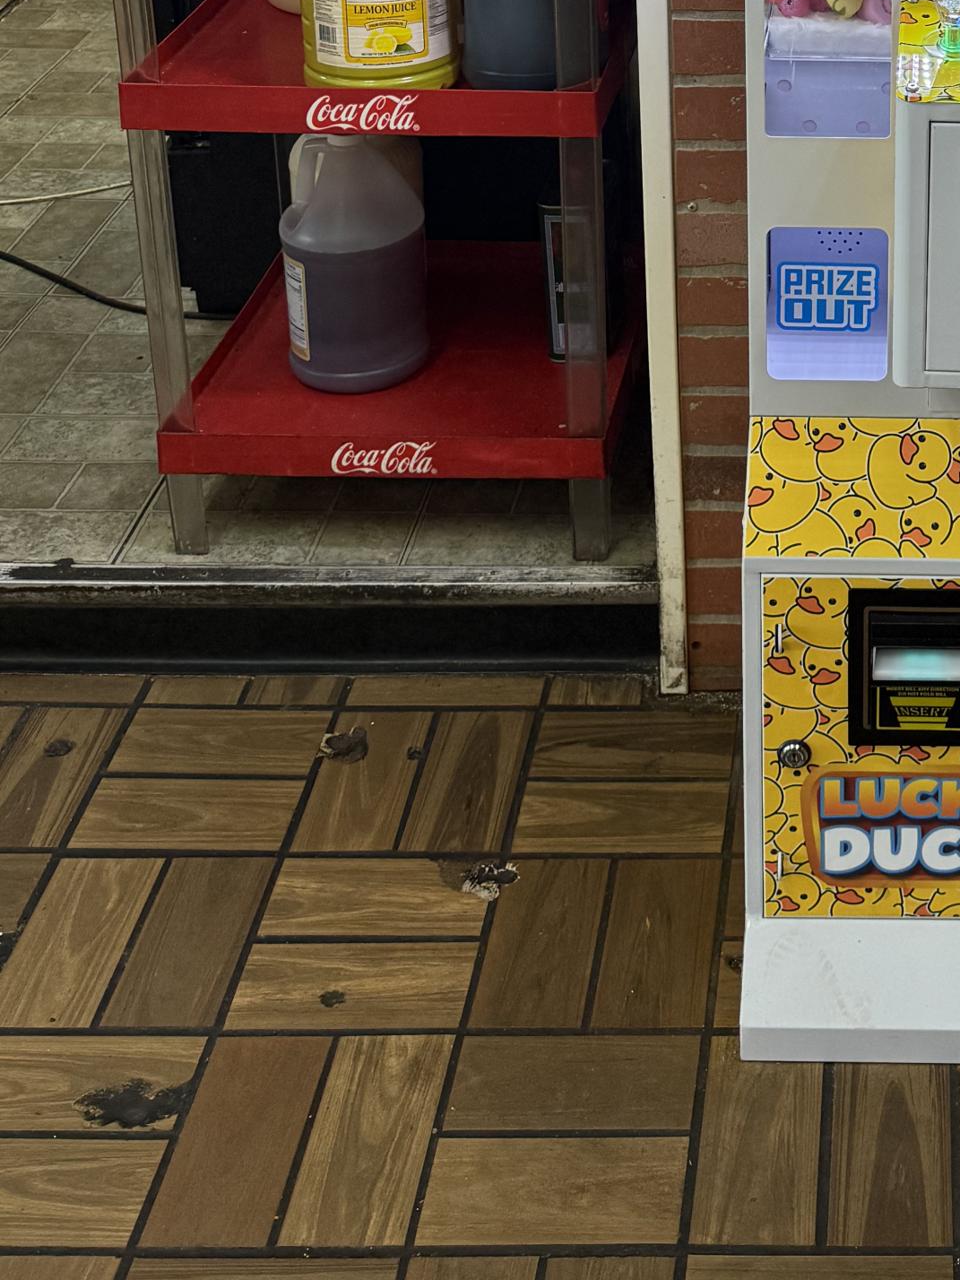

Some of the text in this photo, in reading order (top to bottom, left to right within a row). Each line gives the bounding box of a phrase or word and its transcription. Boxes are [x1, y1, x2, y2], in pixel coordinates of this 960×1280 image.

[354, 1, 417, 15] LEMON JUICE
[783, 267, 874, 297] PRIZE
[783, 297, 874, 327] OUT
[894, 707, 952, 717] INSERT
